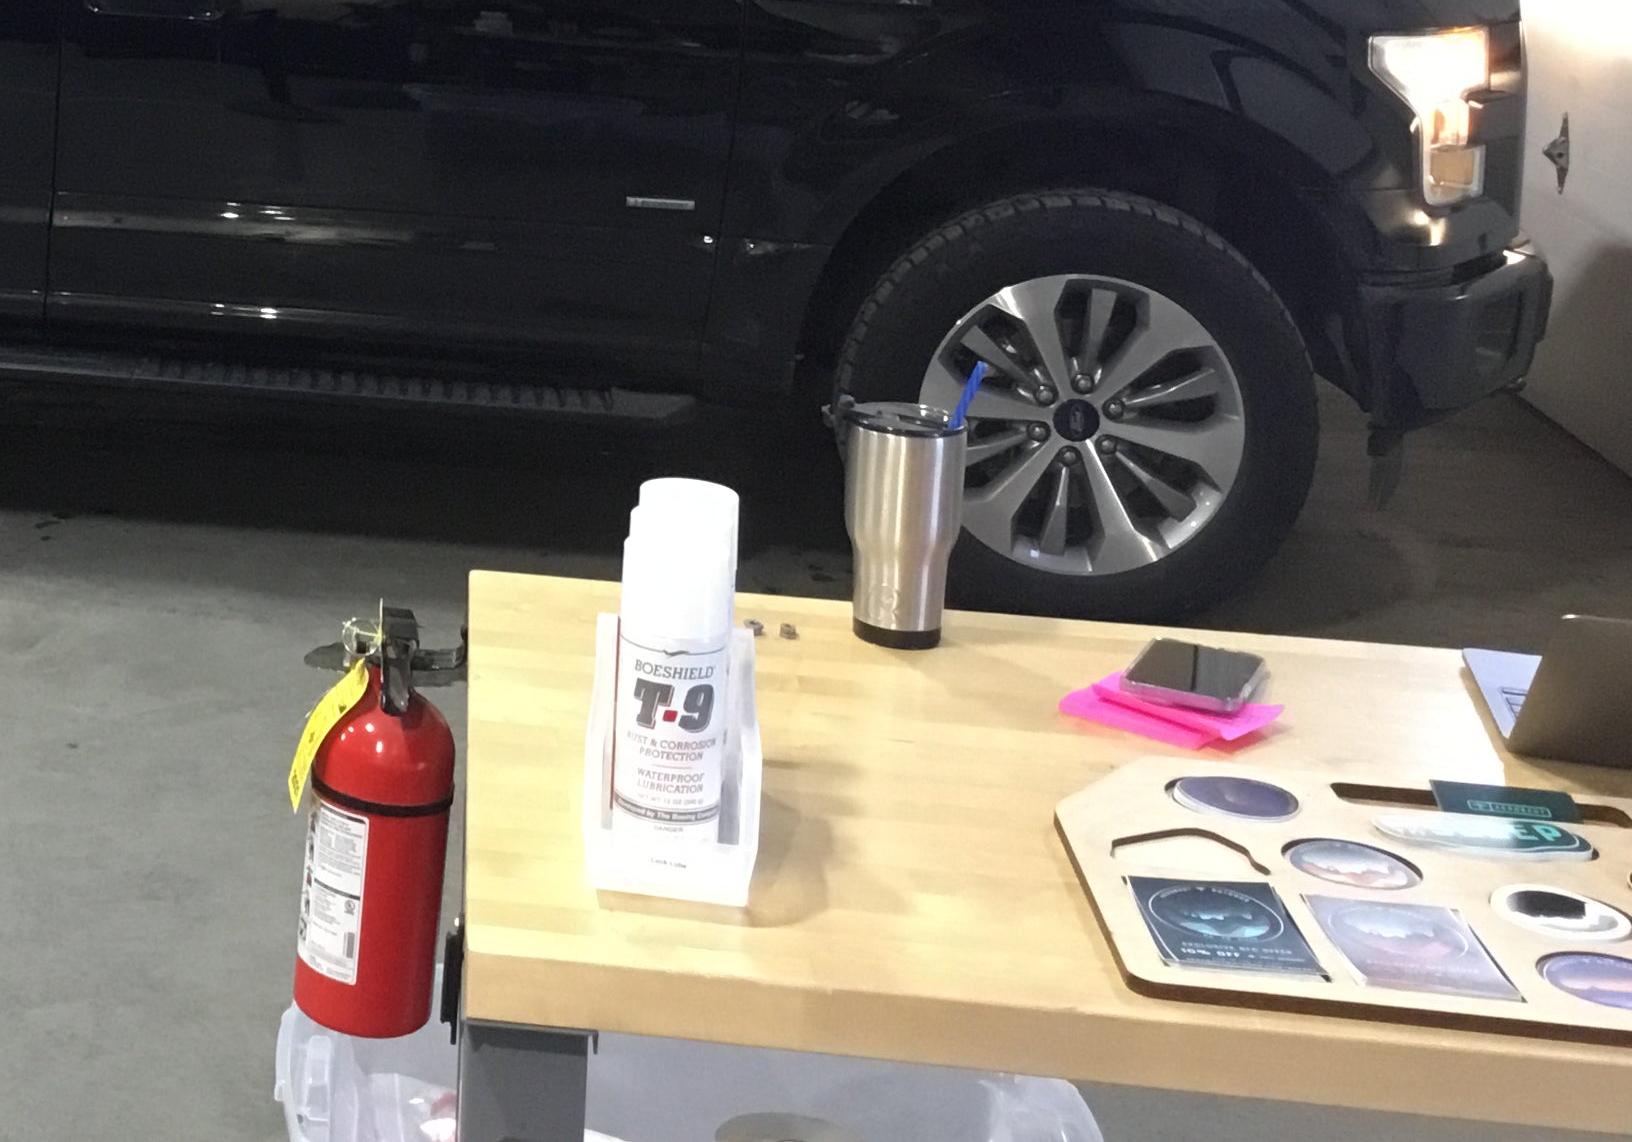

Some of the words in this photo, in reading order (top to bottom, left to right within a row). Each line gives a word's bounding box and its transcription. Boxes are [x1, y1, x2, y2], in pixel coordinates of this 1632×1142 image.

[634, 659, 714, 680] BOESHIELD
[626, 731, 648, 745] RUST
[650, 738, 658, 747] &
[659, 738, 716, 751] CORROSION
[639, 746, 704, 761] PROTECTION
[637, 767, 705, 783] WATERPROOF
[637, 777, 704, 794] LUBRICATION
